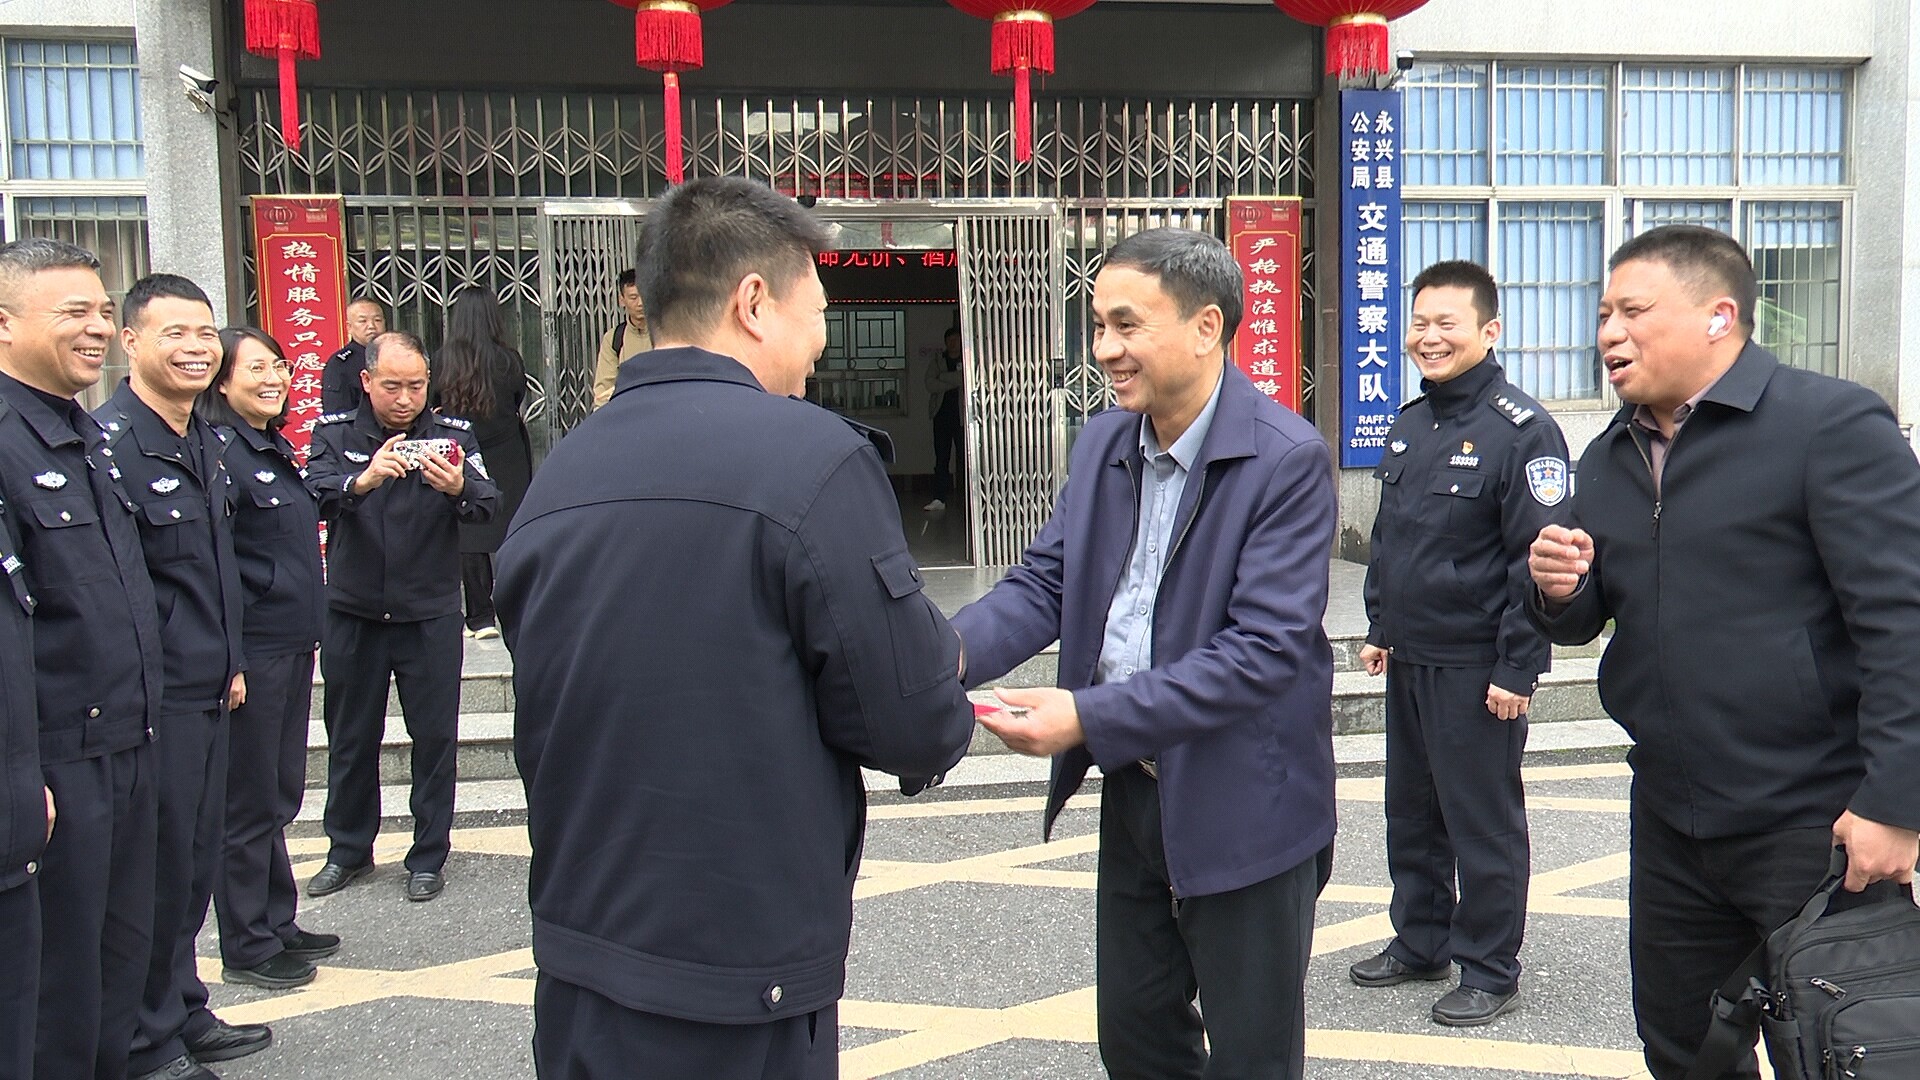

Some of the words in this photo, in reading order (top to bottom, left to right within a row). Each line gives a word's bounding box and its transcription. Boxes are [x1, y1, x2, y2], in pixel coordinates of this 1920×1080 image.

[1350, 110, 1371, 190] 公安局
[1374, 110, 1395, 190] 永兴县
[1248, 237, 1282, 403] 严格执法惟求道路
[1357, 201, 1389, 403] 交通警察大队
